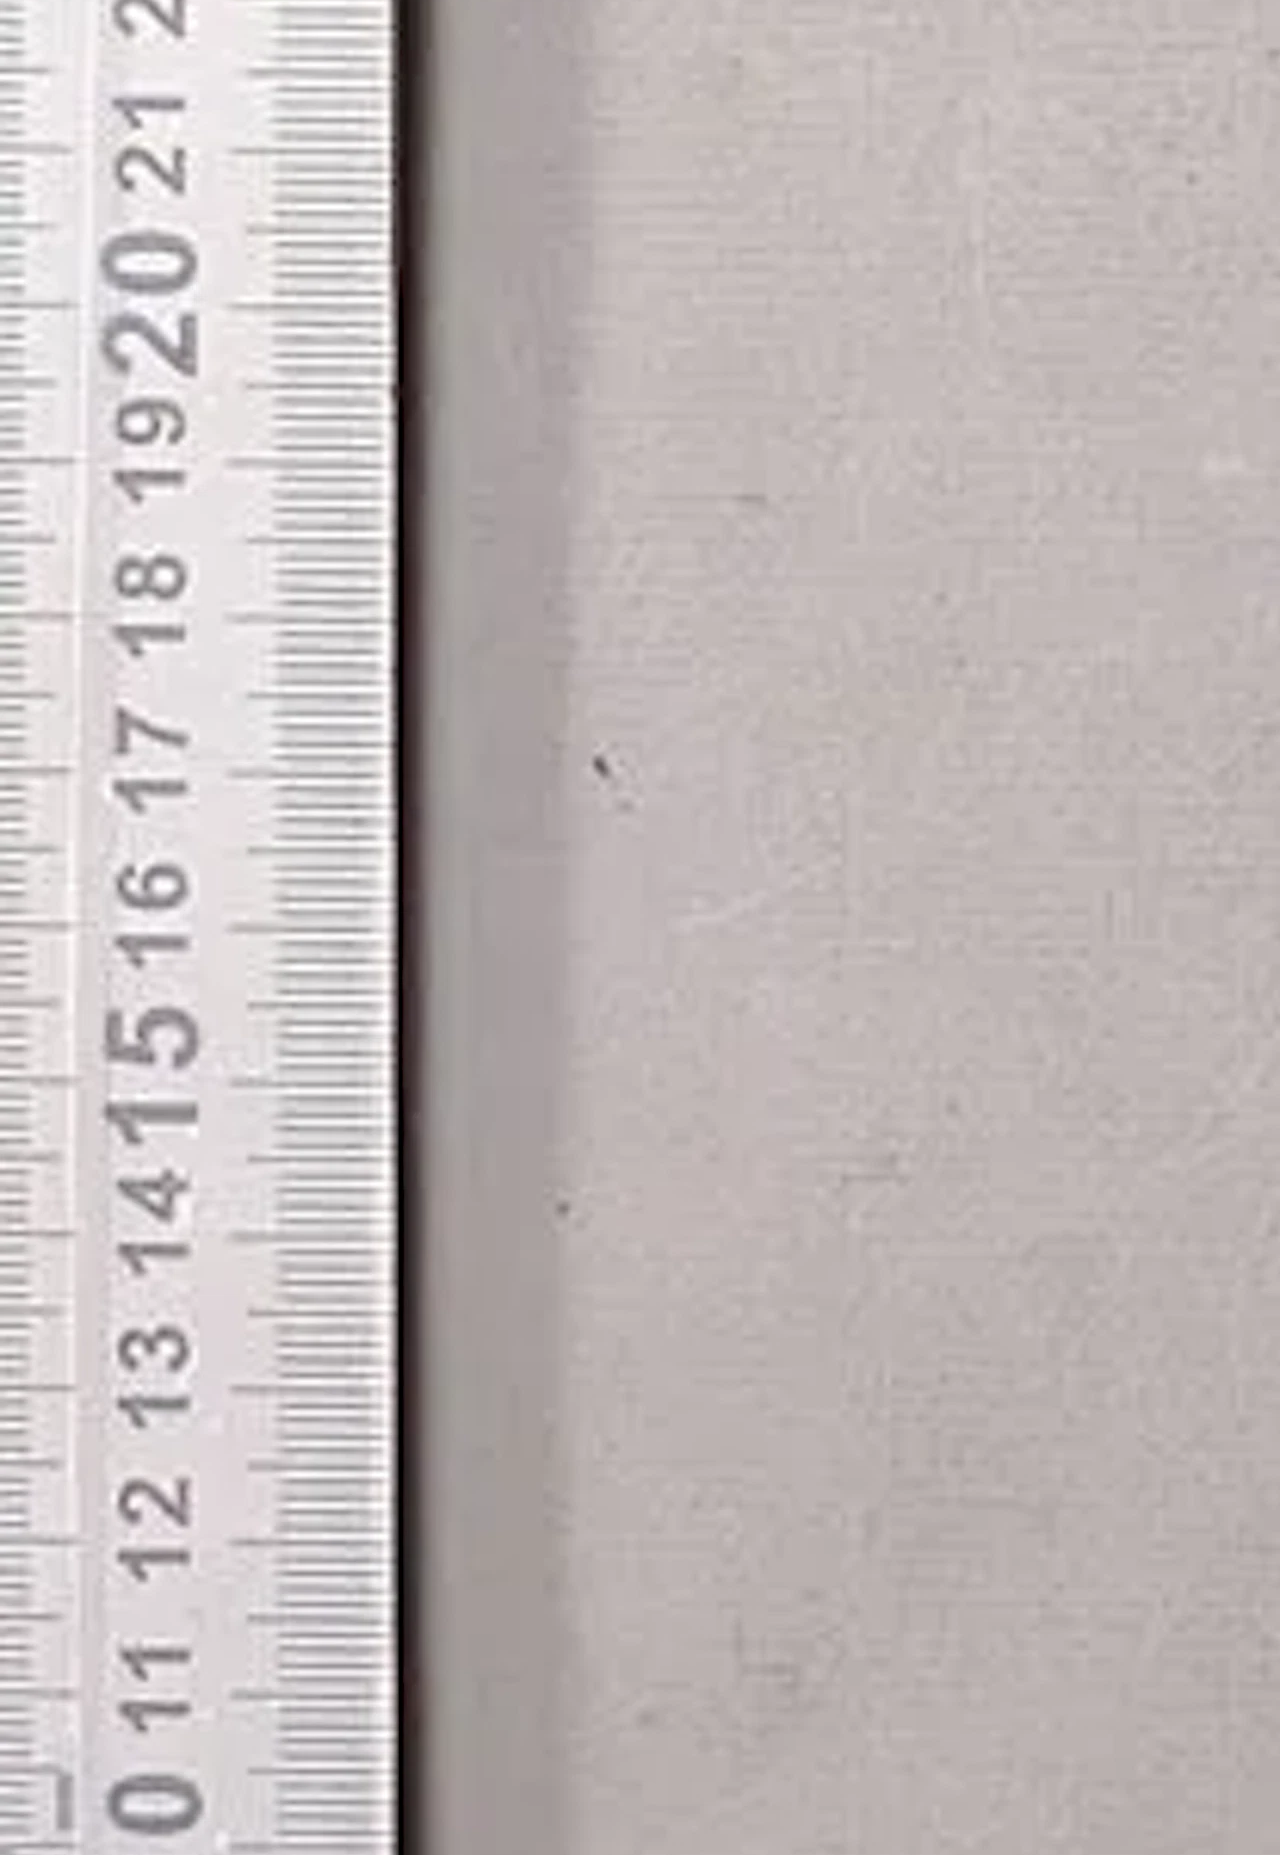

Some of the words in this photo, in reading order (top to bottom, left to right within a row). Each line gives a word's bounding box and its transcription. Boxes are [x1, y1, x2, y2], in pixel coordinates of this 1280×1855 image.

[110, 96, 187, 195] 21
[98, 230, 198, 377] 20
[112, 397, 186, 504] 19
[111, 554, 188, 658] 18
[111, 706, 189, 814] 17
[113, 863, 189, 969] 16
[101, 1006, 200, 1146] 15
[116, 1168, 190, 1277] 14
[116, 1325, 191, 1429] 13
[116, 1478, 191, 1582] 12
[118, 1647, 192, 1734] 11
